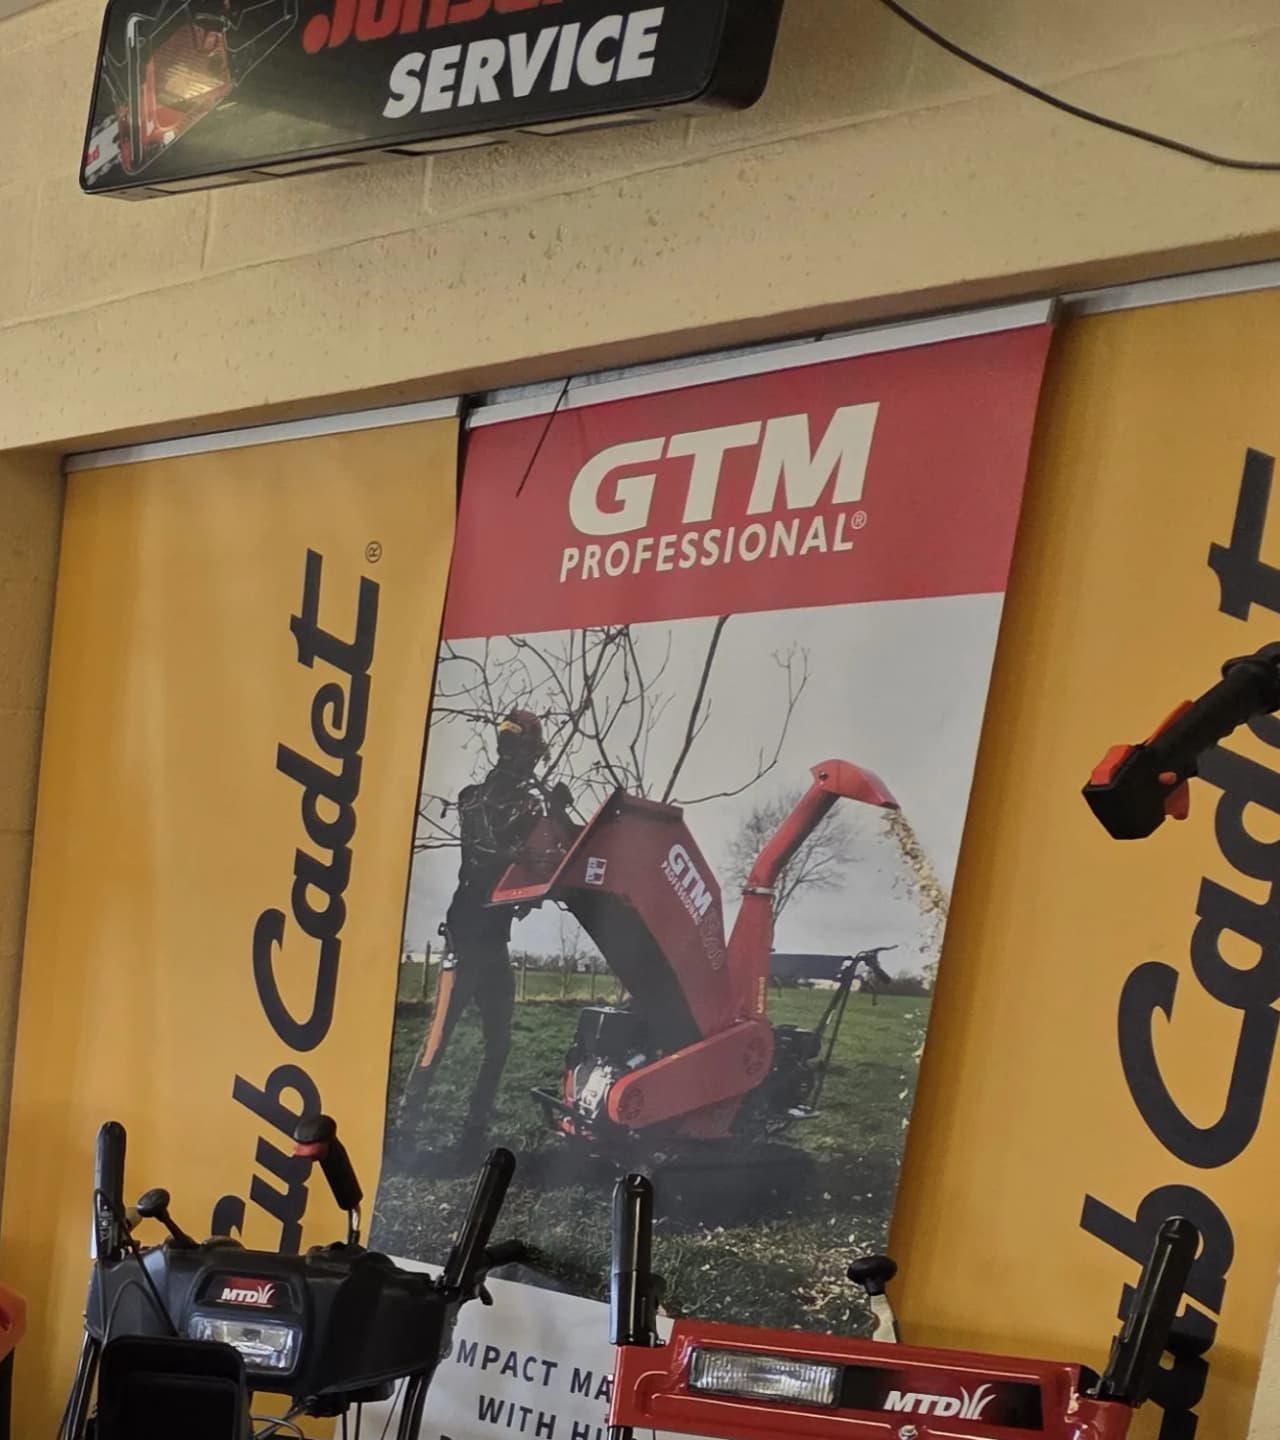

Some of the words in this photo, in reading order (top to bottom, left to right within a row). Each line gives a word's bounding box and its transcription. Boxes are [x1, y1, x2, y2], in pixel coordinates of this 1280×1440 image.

[382, 7, 664, 119] SERVICE
[568, 401, 881, 536] GTM
[668, 843, 713, 916] GTM
[221, 1288, 259, 1302] MTD
[449, 1338, 558, 1387] MPACT
[478, 1395, 557, 1440] WITH
[883, 1390, 962, 1417] MTD
